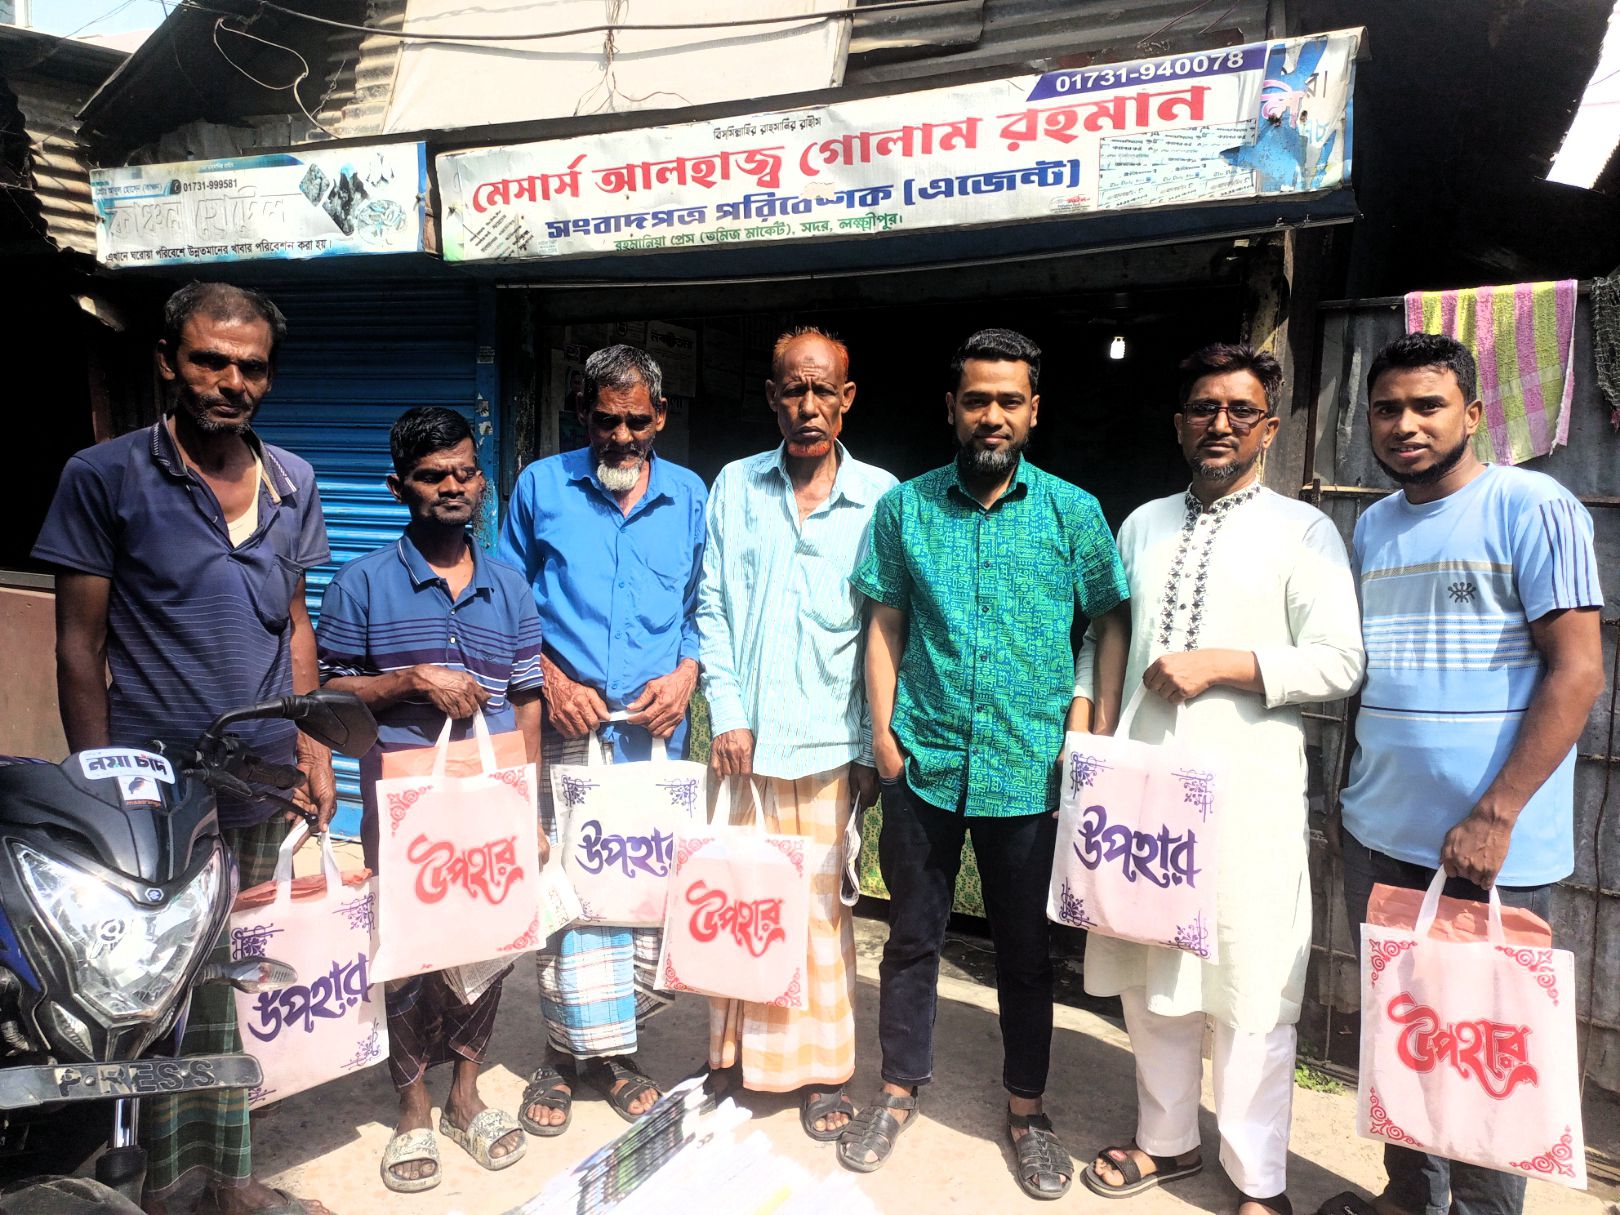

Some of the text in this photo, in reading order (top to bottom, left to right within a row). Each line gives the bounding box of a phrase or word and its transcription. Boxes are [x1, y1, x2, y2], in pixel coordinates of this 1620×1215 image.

[1055, 51, 1244, 92] 01731-940078
[473, 154, 587, 213] মেসার্স
[592, 146, 785, 189] আলহাজ্ব
[800, 117, 983, 176] গোলাম
[996, 85, 1211, 151] রহমান
[183, 179, 238, 192] 01731-999581
[545, 205, 708, 238] সংবাদপত্র
[670, 233, 696, 246] প্রেস
[297, 240, 313, 251] করা
[1073, 805, 1202, 889] উপহার
[407, 833, 524, 906] উপহার
[686, 879, 786, 958] উপহার
[1387, 991, 1539, 1101] উপহার
[57, 1059, 216, 1097] PRESS
